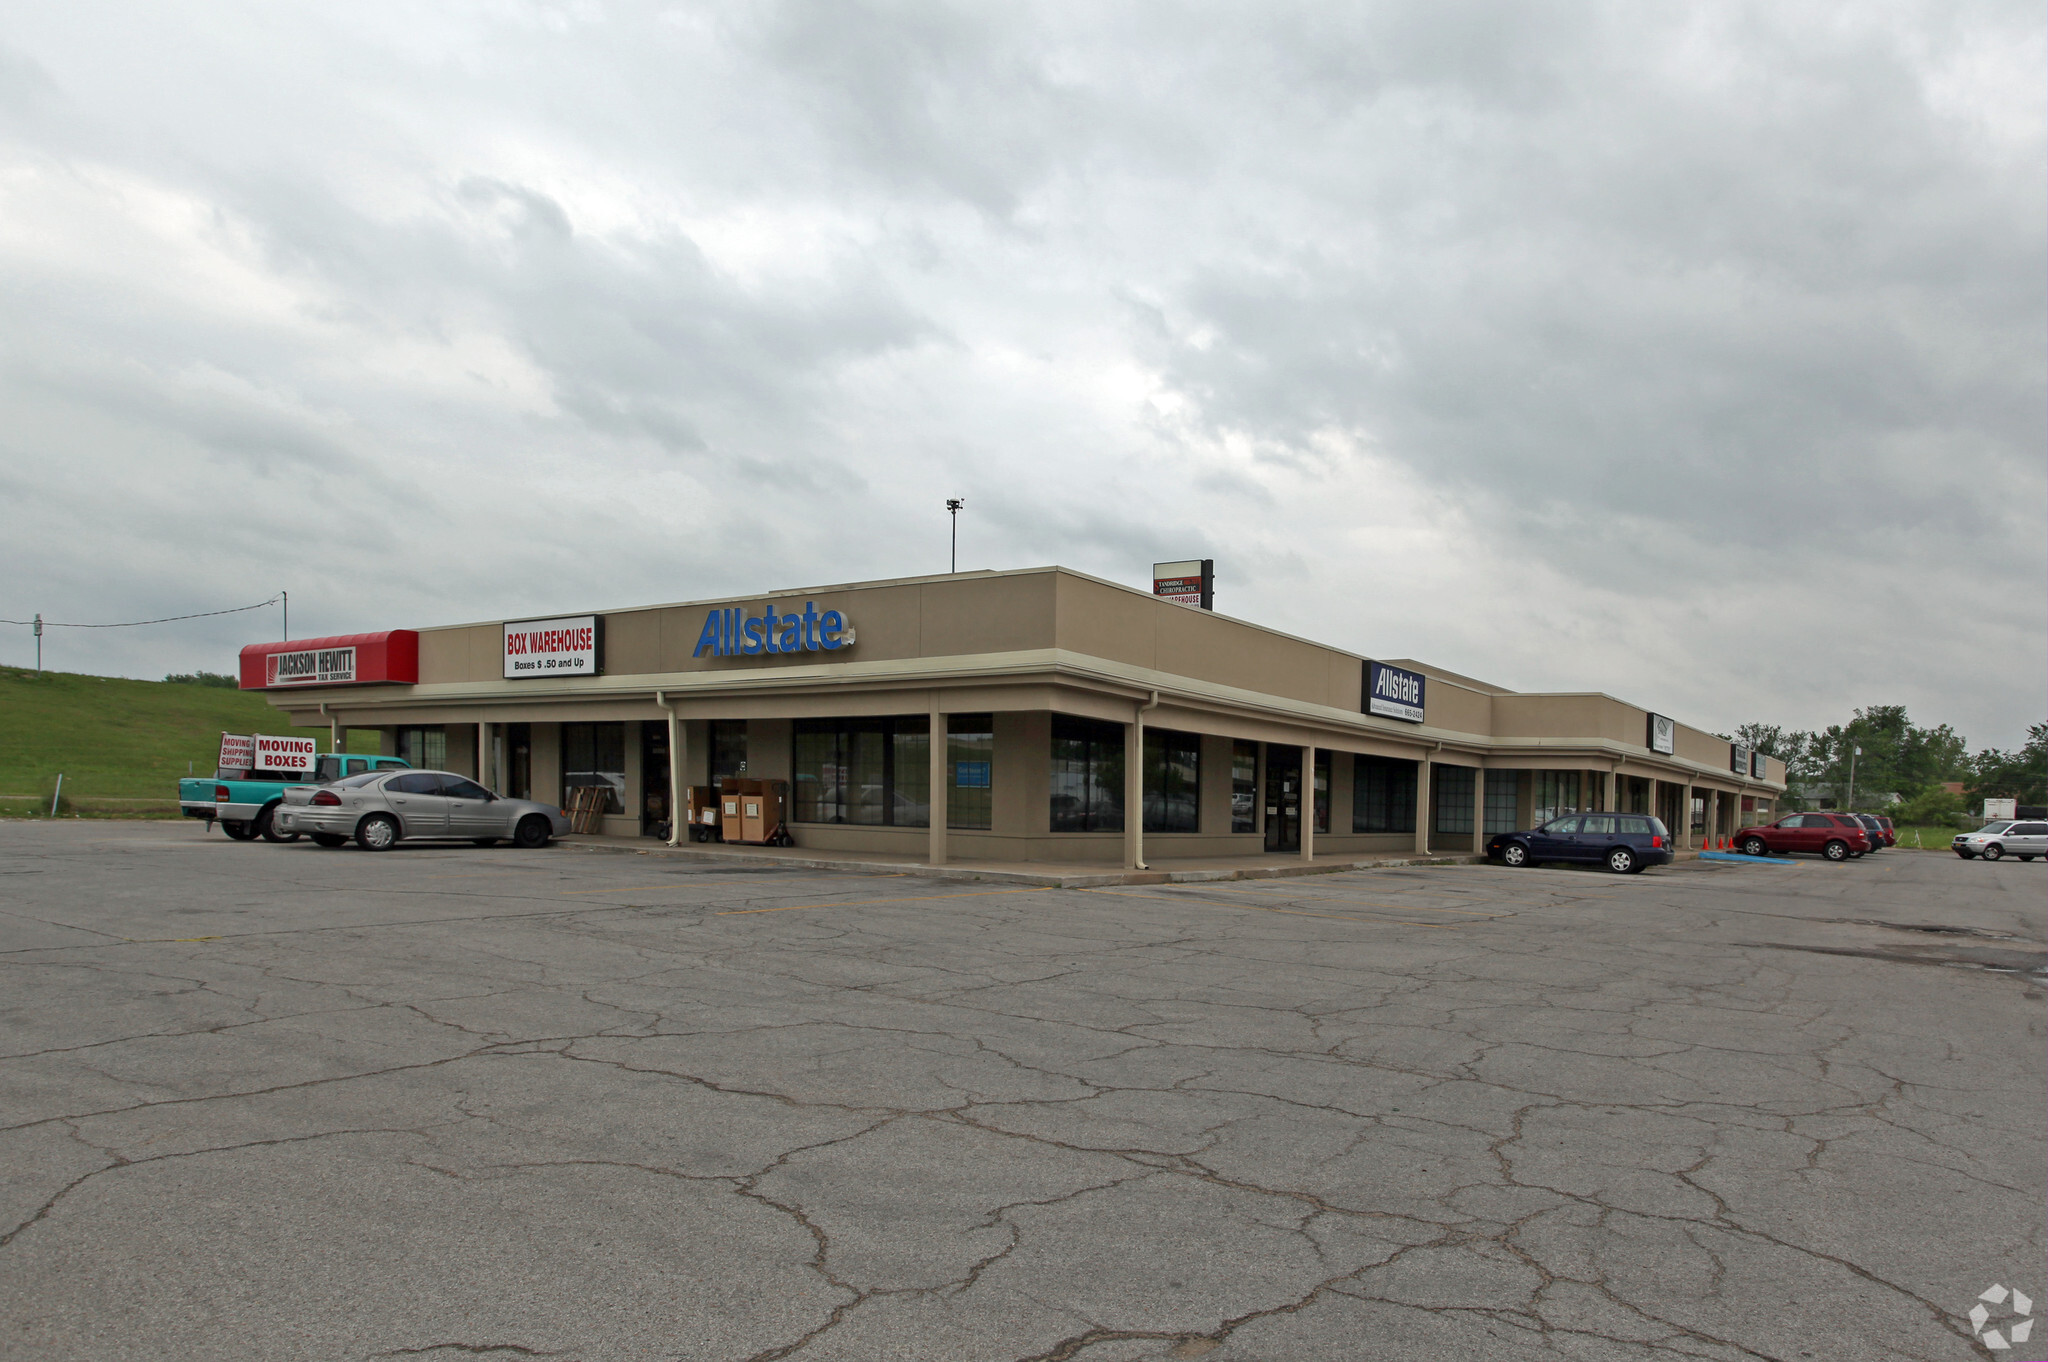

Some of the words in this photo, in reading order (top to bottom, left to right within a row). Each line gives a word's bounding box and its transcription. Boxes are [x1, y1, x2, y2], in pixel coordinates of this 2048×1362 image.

[693, 601, 843, 657] Allstate
[508, 633, 527, 655] BOX
[530, 628, 592, 653] WAREHOUSE
[278, 652, 316, 675] JACKSON
[319, 649, 353, 672] HEWITT
[515, 661, 535, 670] Boxes
[558, 658, 571, 668] and
[574, 658, 584, 668] Up
[318, 673, 328, 681] TAX
[330, 672, 352, 680] SERVICE
[1376, 668, 1418, 704] Allstate
[225, 738, 250, 748] MOVING
[259, 740, 313, 753] MOVING
[223, 747, 253, 757] SHIPPING
[221, 757, 252, 766] SUPPLIES
[265, 755, 307, 767] BOXES
